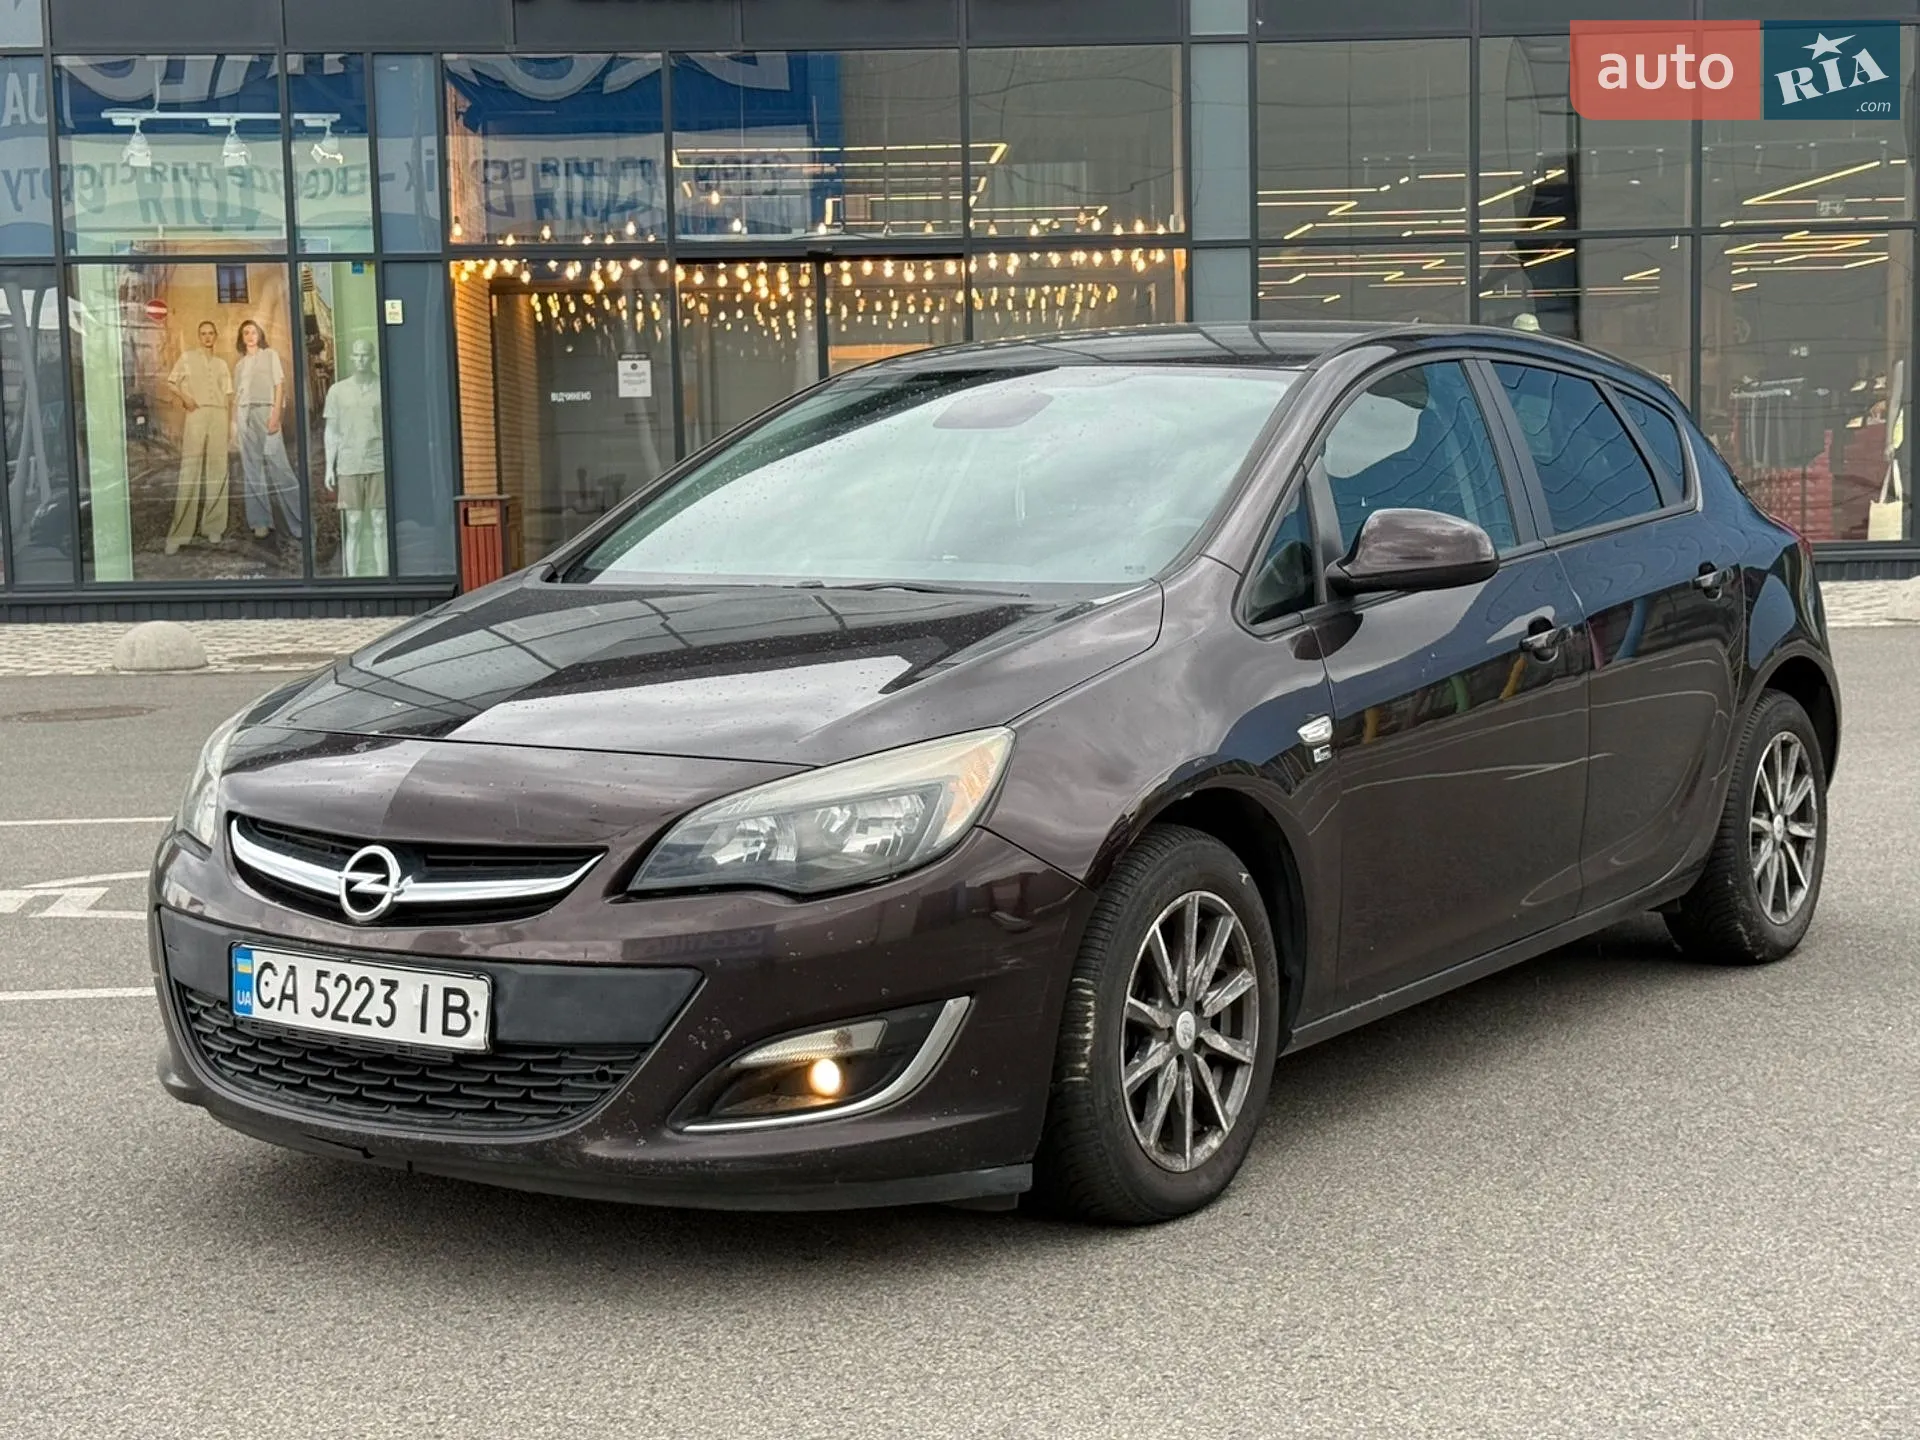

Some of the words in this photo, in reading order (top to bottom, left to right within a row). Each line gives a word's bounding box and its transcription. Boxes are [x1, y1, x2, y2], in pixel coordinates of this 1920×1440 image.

[237, 990, 252, 1006] UA
[256, 961, 298, 1014] CA
[311, 969, 399, 1028] 5223
[420, 984, 471, 1038] IB
